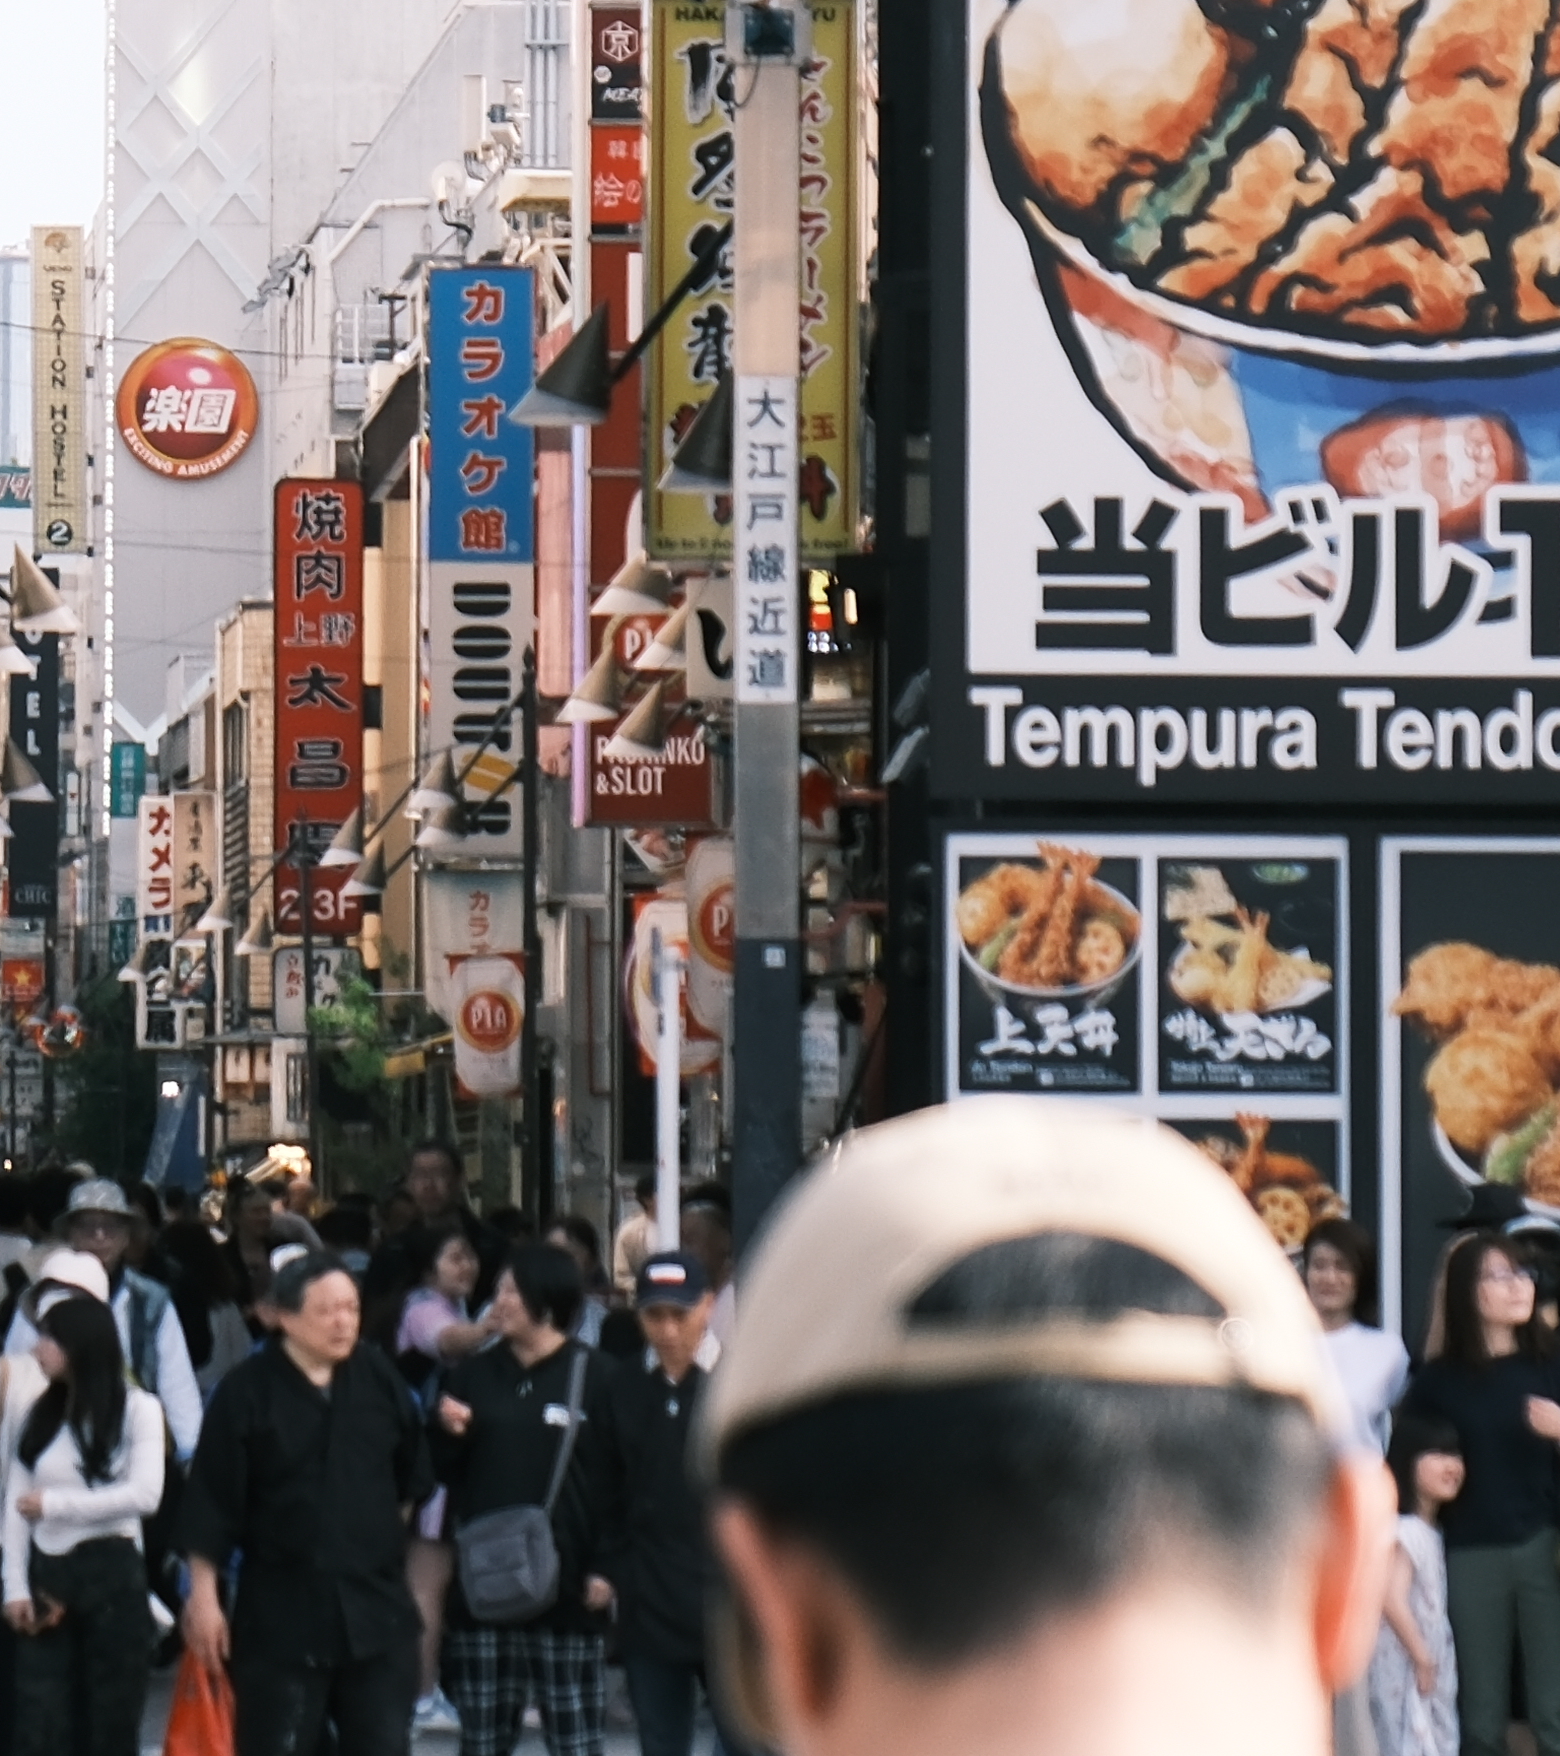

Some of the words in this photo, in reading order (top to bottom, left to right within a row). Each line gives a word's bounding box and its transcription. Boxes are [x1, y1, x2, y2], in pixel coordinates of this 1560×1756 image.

[51, 279, 67, 391] STATION
[51, 404, 68, 498] HOSTEL
[142, 385, 237, 434] 楽園
[460, 282, 506, 553] カラオケ館
[293, 488, 347, 600] 焼肉
[745, 386, 787, 688] 大江戸線近道
[283, 610, 355, 645] 上野
[969, 686, 1318, 787] Tempura
[468, 889, 492, 954] カラ
